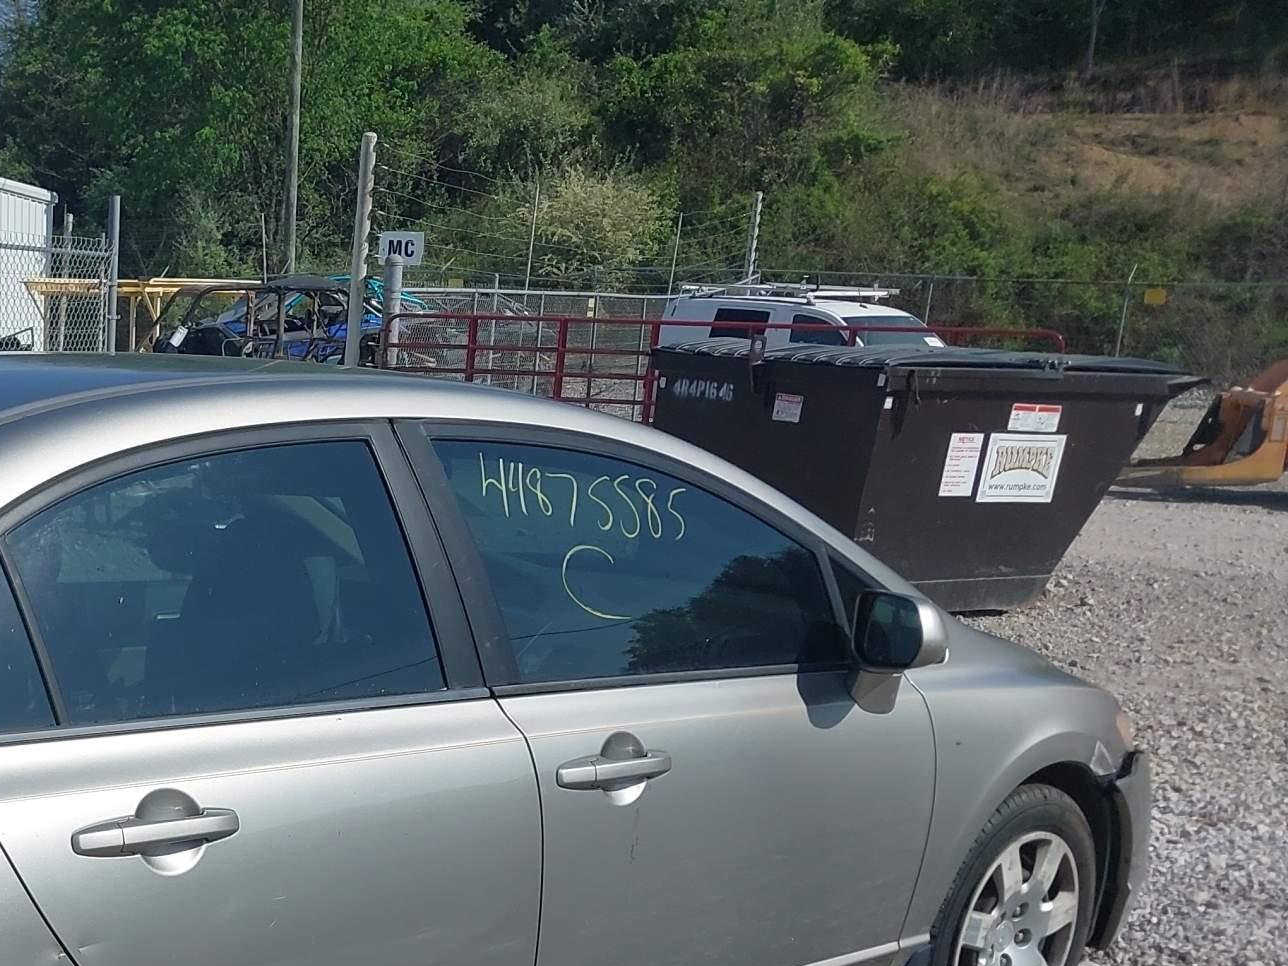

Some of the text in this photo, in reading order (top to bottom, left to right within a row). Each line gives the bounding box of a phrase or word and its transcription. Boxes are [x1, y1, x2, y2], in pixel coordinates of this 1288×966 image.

[388, 239, 415, 258] MC
[480, 452, 686, 540] 44875585
[562, 545, 632, 619] C
